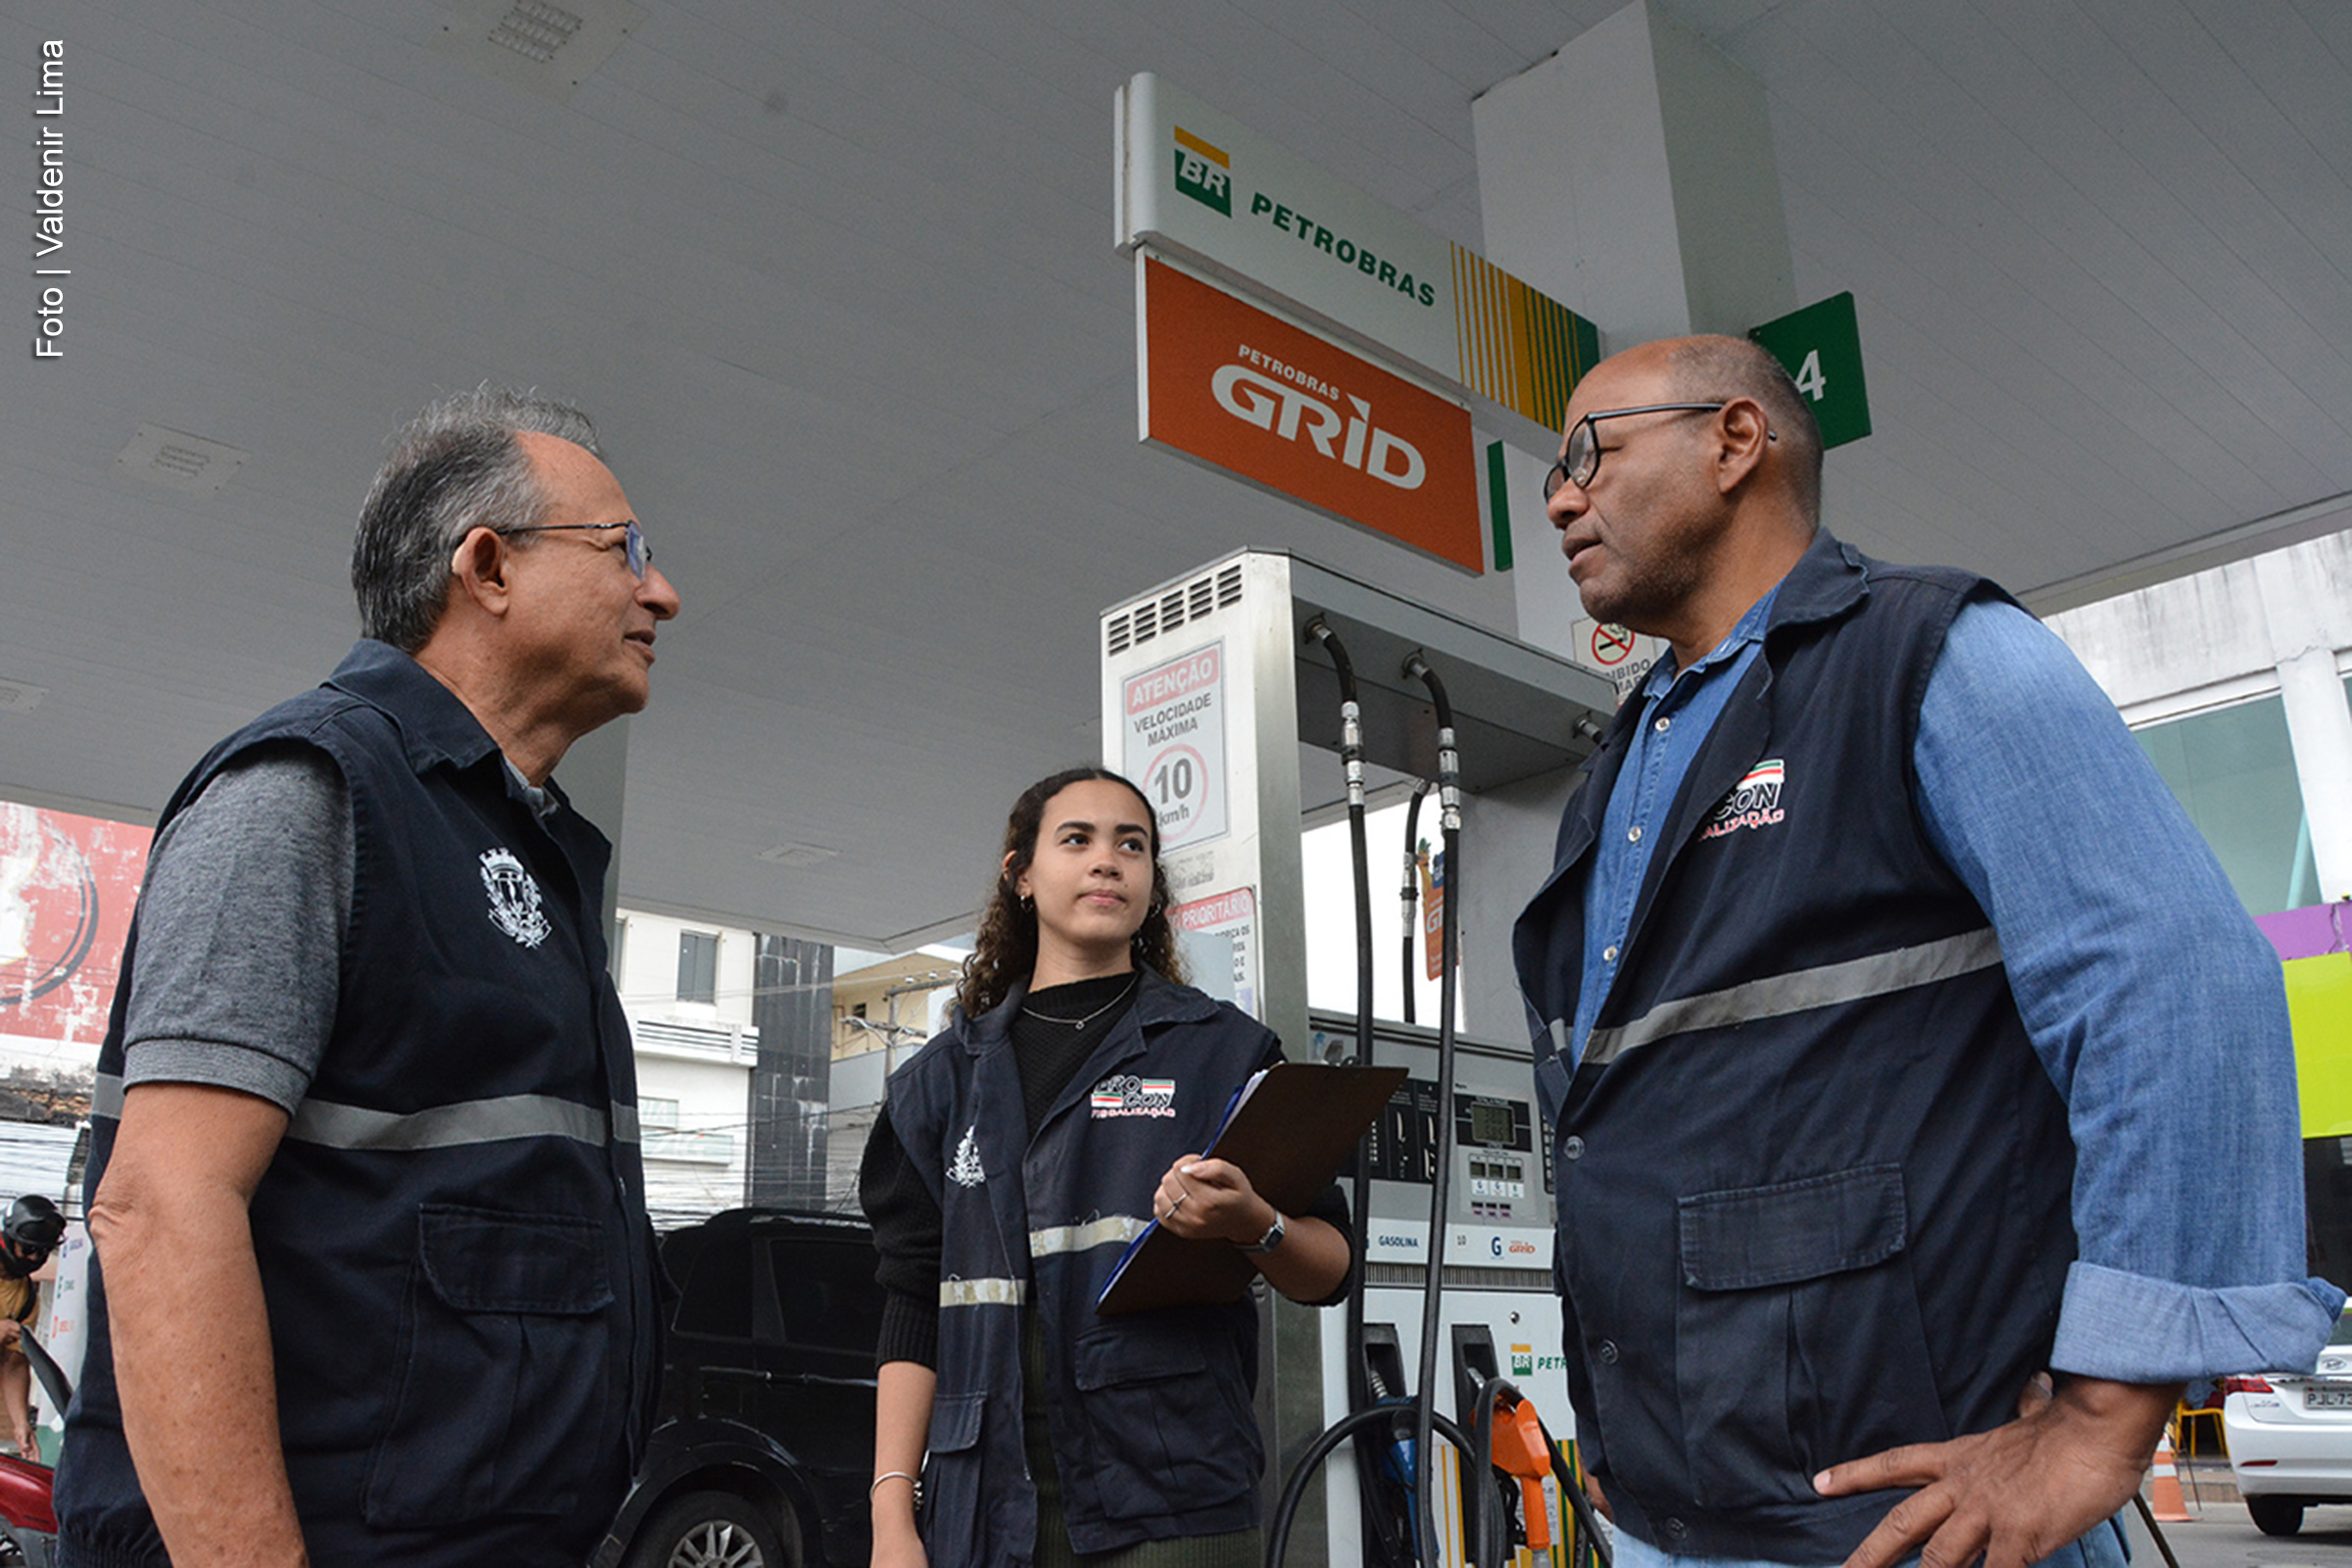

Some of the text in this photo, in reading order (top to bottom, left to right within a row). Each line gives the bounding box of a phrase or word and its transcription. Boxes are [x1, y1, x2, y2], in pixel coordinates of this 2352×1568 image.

[1178, 152, 1436, 308] BR PETROBRAS
[1238, 343, 1340, 402] PETROBRAS
[1794, 349, 1827, 403] 4
[1211, 364, 1427, 490] GRID
[1131, 655, 1213, 709] ATENÇÃO
[1607, 659, 1651, 680] IBIDO
[1133, 692, 1212, 733] VELOCIDADE
[1147, 716, 1199, 747] MÁXIMA
[1154, 758, 1193, 805] 10
[1702, 808, 1785, 840] ALIZAÇÃO
[1182, 894, 1250, 929] PRIORITÁRIO
[1378, 1235, 1419, 1249] GASOLINA
[1491, 1235, 1502, 1256] G
